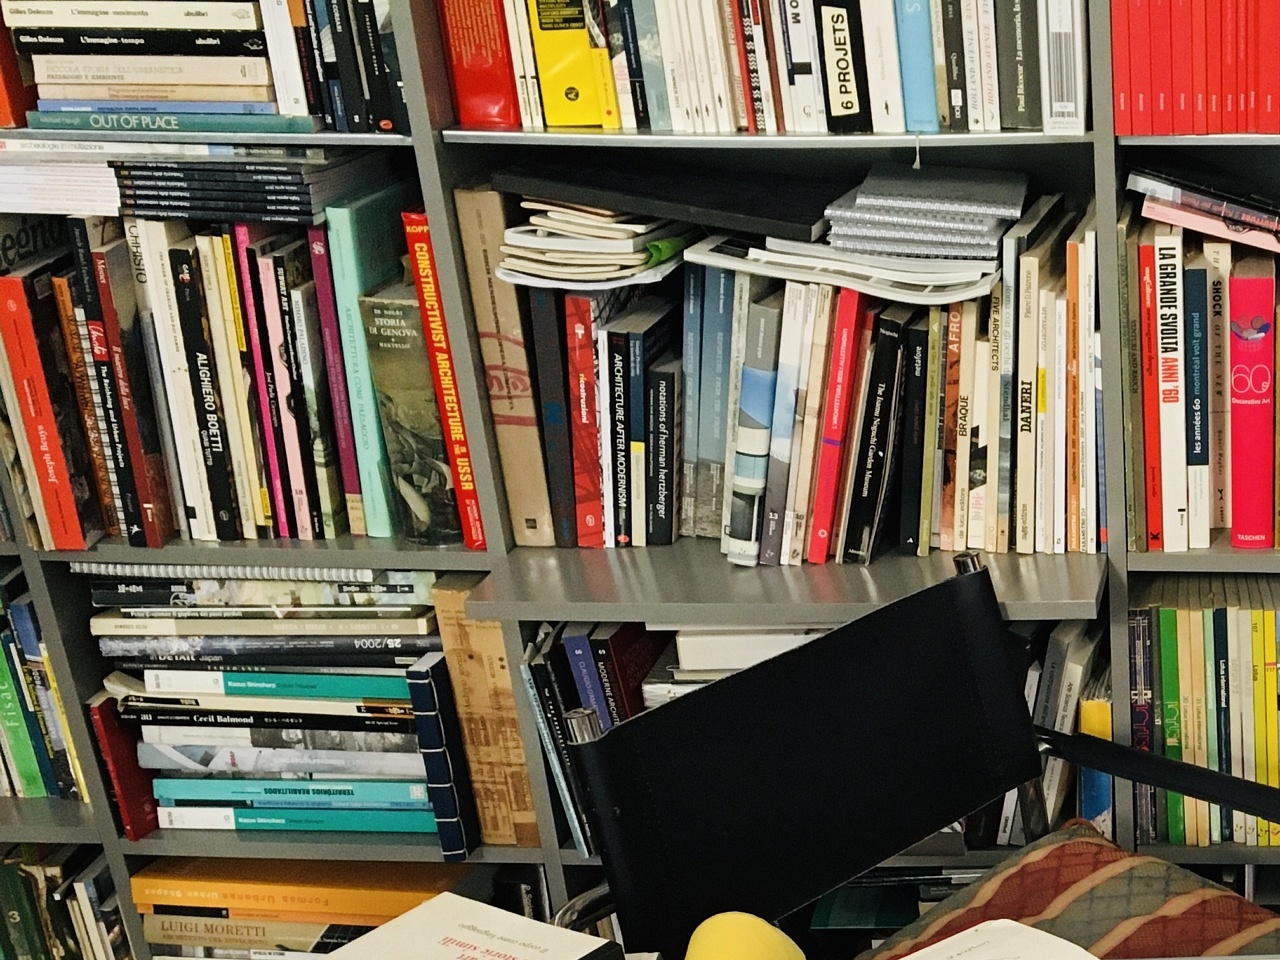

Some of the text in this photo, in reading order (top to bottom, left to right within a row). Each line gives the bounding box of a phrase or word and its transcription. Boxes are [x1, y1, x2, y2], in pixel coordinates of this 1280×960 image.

[832, 13, 855, 111] 6 PROJETS
[970, 66, 980, 111] HOLLAND
[985, 62, 995, 106] HOLLAND
[1016, 93, 1026, 113] Paul
[90, 114, 179, 130] OUT OF PLACE
[405, 225, 429, 233] KOPP
[128, 224, 148, 284] CHRISTO
[1212, 280, 1223, 317] SHOCK
[369, 325, 418, 337] DI GENOVA
[375, 317, 407, 328] STORIA
[948, 310, 961, 353] AFRO
[990, 296, 1000, 371] FIVE ARCHITECTS
[1159, 246, 1180, 404] LA GRANDE SVOLTA ANNI '60
[414, 242, 473, 491] CONSTRUCTIVIST ARCHITECTURE USSR
[914, 346, 923, 378] metafore
[1231, 364, 1272, 394] 60s
[578, 372, 590, 424] ricostruzioni
[877, 383, 886, 397] The
[1193, 312, 1203, 454] les années 60 montréal voit grand
[196, 352, 224, 452] ALIGHIERO BOETTI
[958, 395, 969, 437] BRAQUE
[1021, 379, 1032, 433] DANERI
[1231, 397, 1260, 407] Decorative
[612, 352, 627, 508] ARCHITECTURE AFTER MODERNISM
[656, 379, 668, 519] notations of herman hertzberger
[1237, 533, 1266, 542] TASCHEN
[353, 637, 402, 649] 25/2004
[597, 660, 611, 698] MODERNE
[1219, 659, 1227, 678] Lotus
[192, 713, 254, 724] Cecil Balmond
[160, 921, 268, 938] LUIGI MORETTI
[438, 935, 477, 953] simili
